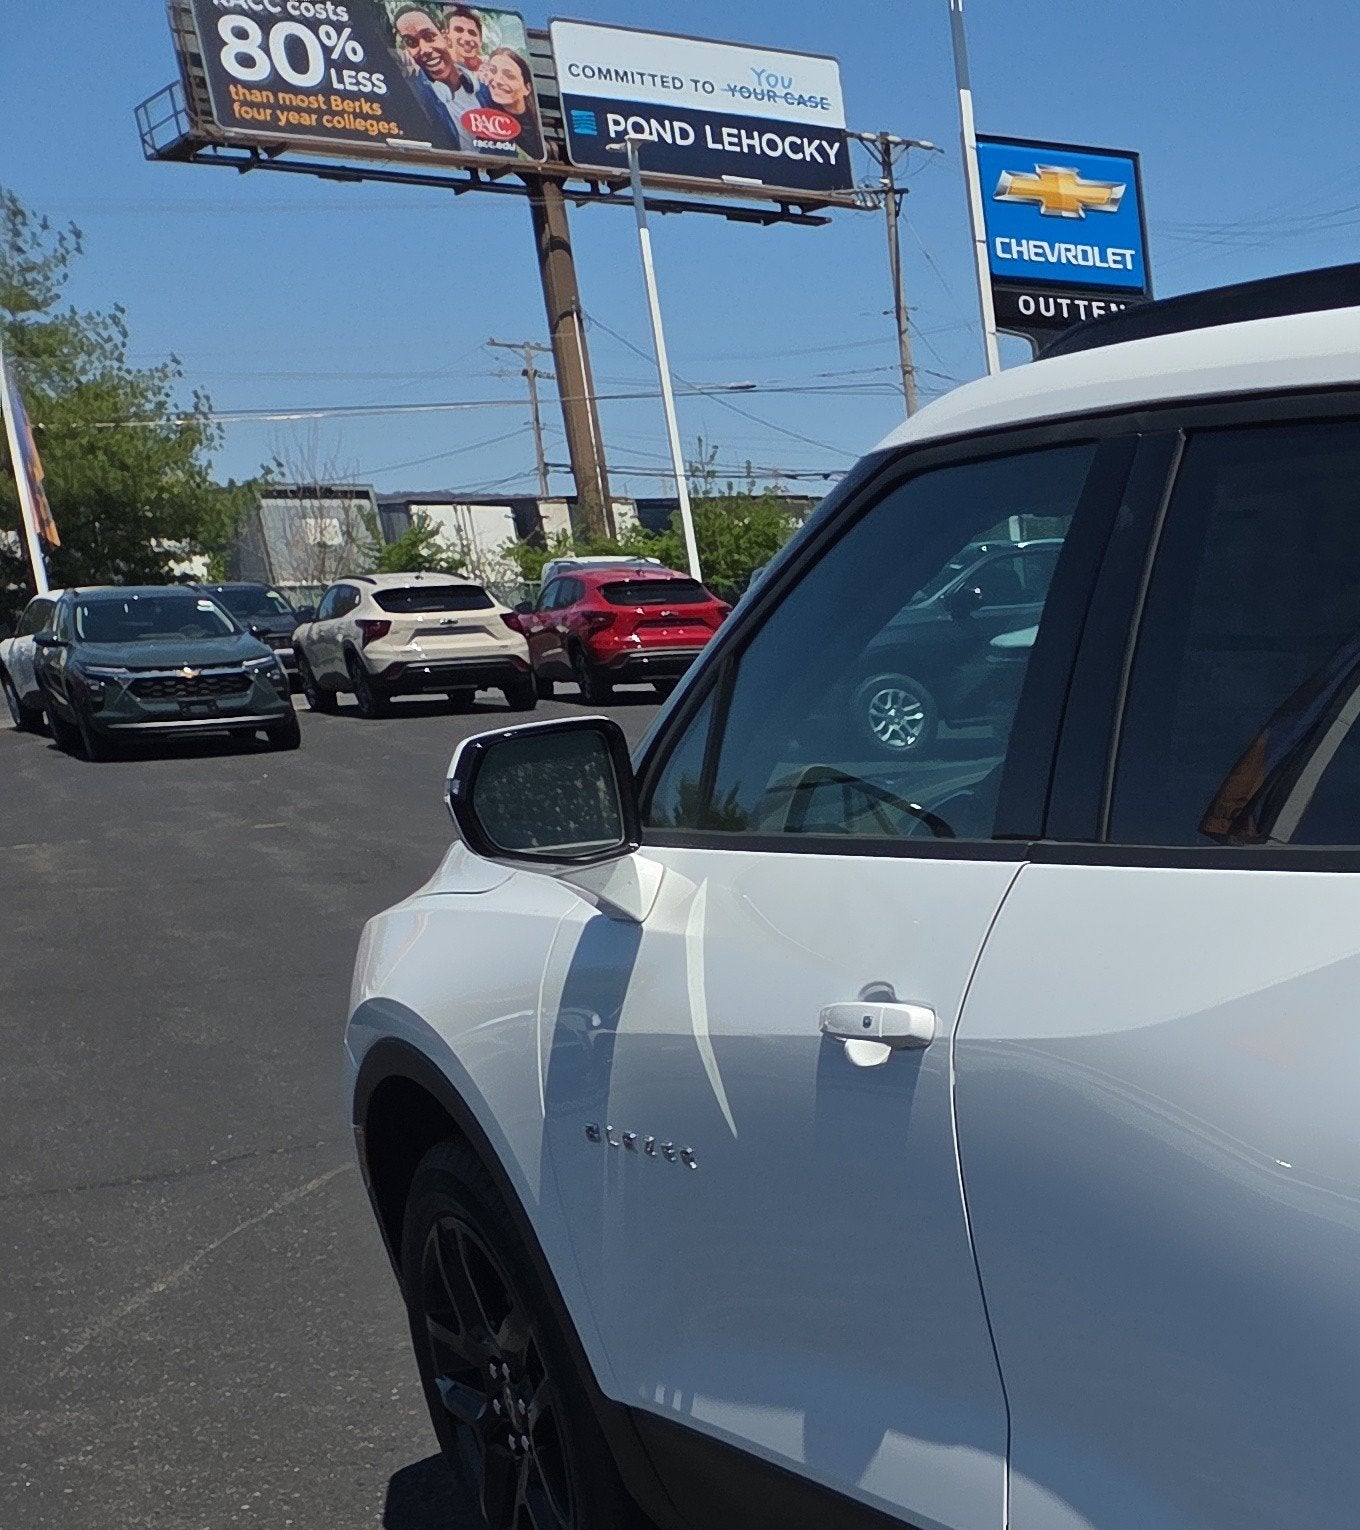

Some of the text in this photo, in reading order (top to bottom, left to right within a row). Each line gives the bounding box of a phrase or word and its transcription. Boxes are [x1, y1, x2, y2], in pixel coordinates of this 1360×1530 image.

[286, 1, 349, 22] costs
[217, 14, 364, 87] 80%
[330, 68, 387, 95] LESS
[568, 63, 831, 111] COMMITTED TO YOUR CASE
[229, 84, 382, 116] than most Berks
[233, 101, 403, 136] four year colleges.
[469, 113, 512, 137] RACC
[606, 113, 840, 165] POND LEHOCKY
[995, 237, 1136, 270] CHEVROLET
[1018, 295, 1126, 320] OUTTE
